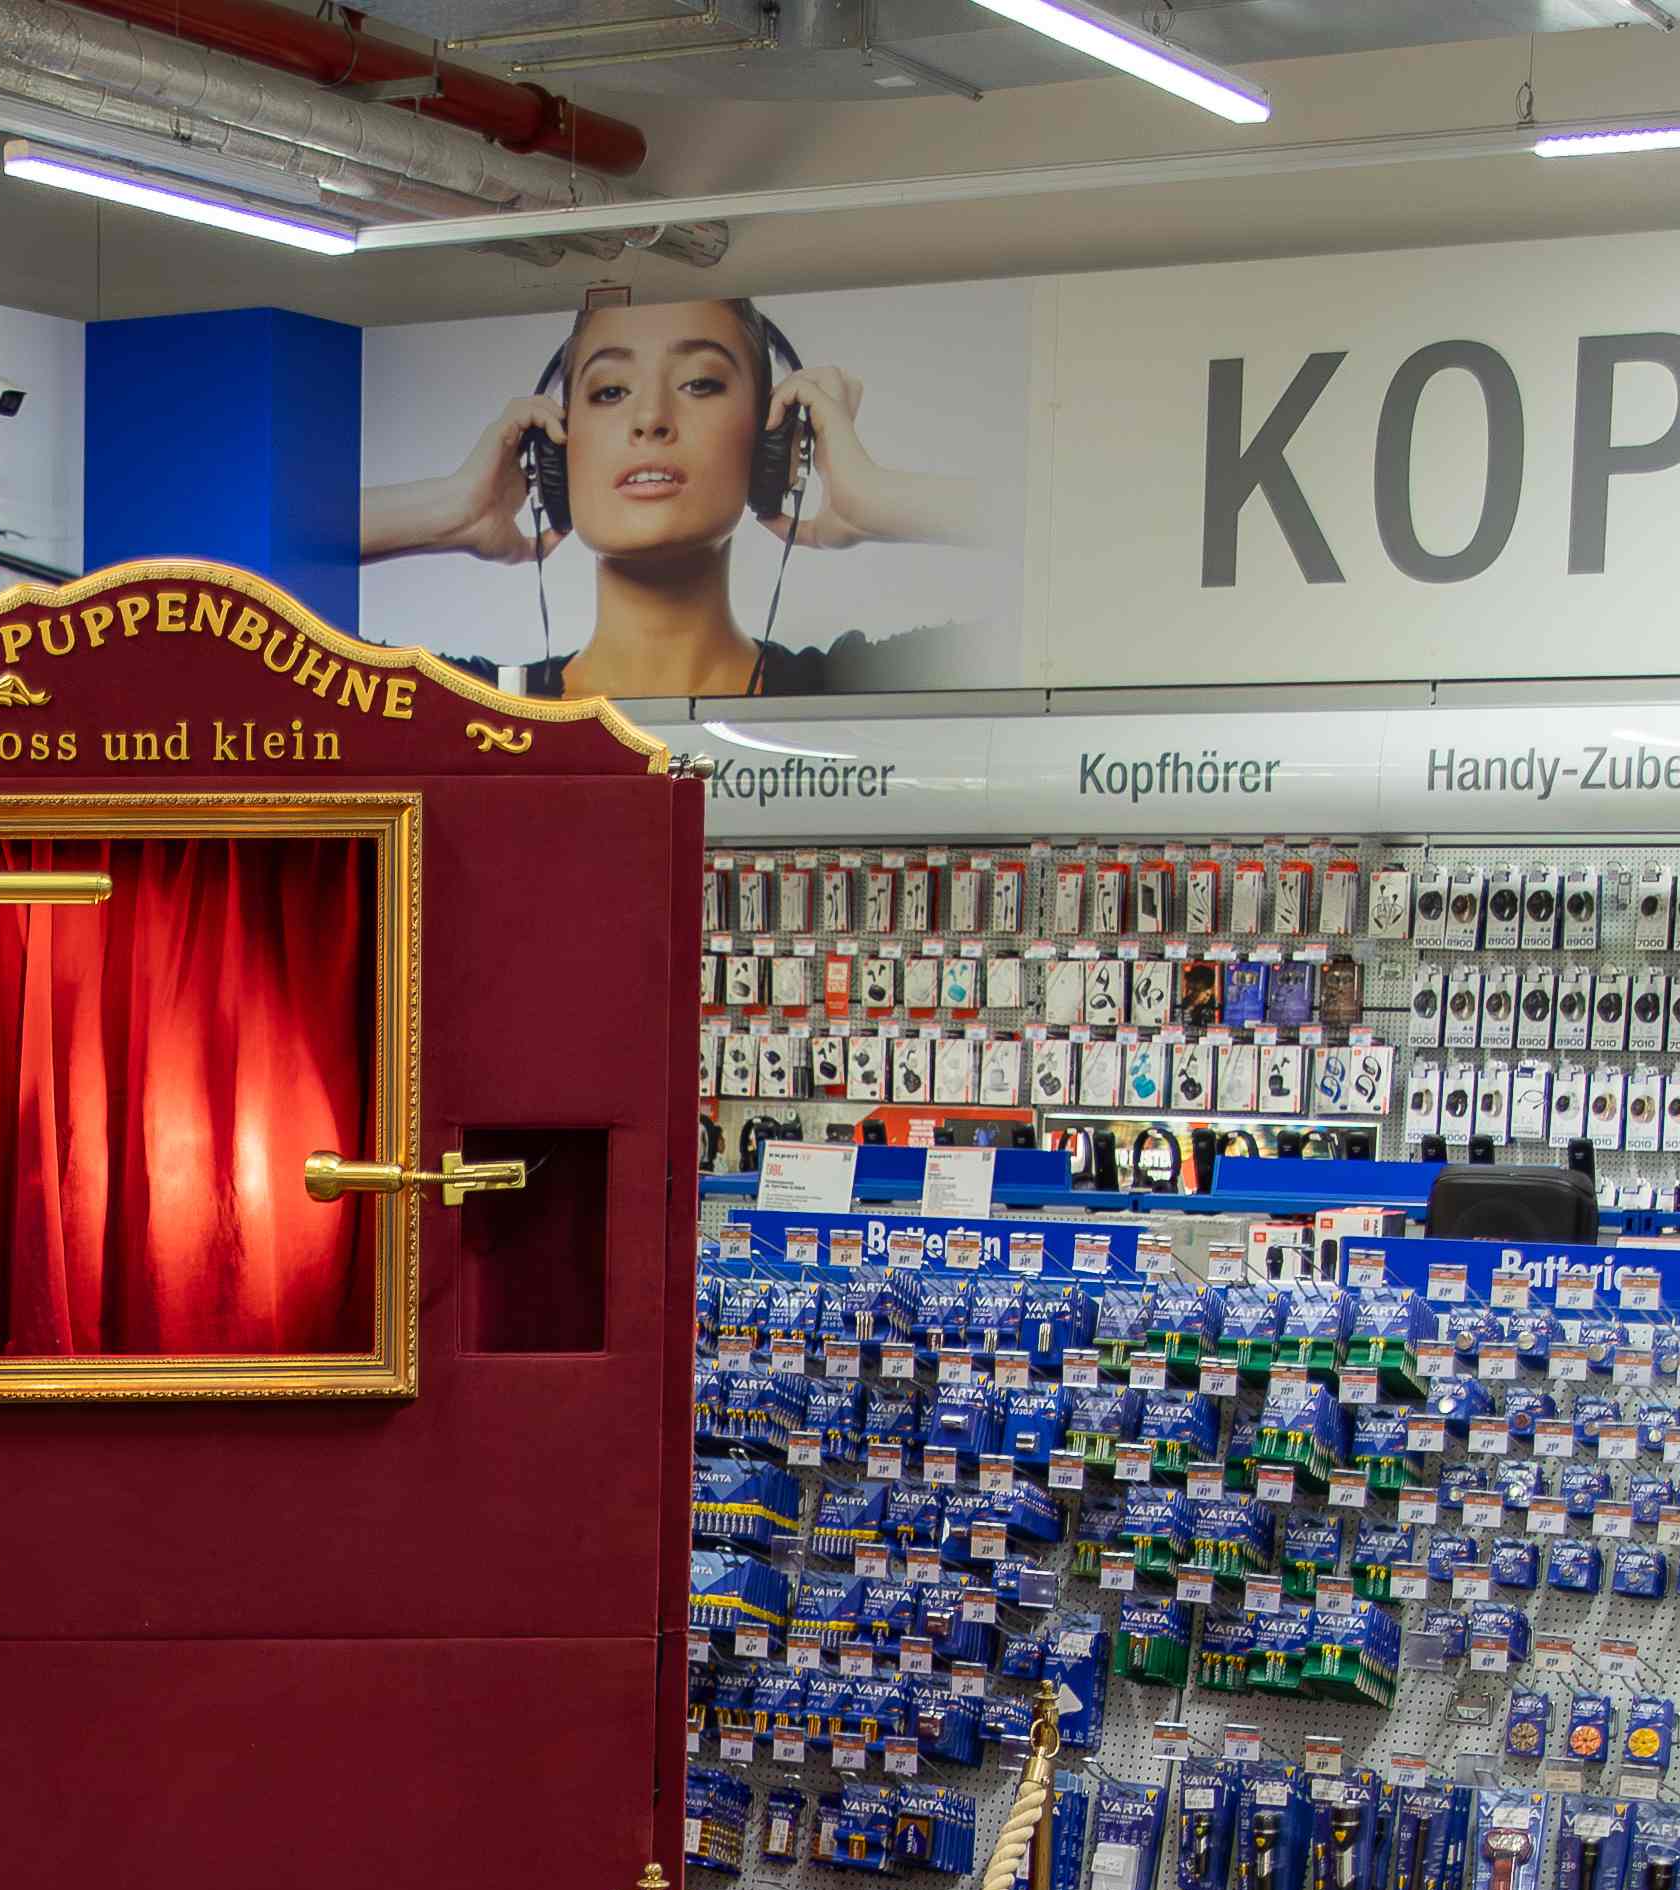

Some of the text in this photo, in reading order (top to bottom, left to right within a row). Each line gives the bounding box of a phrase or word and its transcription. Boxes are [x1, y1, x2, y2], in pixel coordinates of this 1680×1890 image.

[0, 590, 418, 721] PUPPENBÜHNE
[103, 720, 190, 763] und
[213, 718, 341, 763] klein
[709, 755, 896, 802] Kopfhörer
[1078, 749, 1281, 798] Kopfhörer
[848, 1281, 892, 1294] VARTA
[724, 1296, 767, 1309] VARTA
[772, 1296, 816, 1309] VARTA
[921, 1295, 965, 1308] VARTA
[975, 1297, 1020, 1309] VARTA
[1025, 1301, 1071, 1314] VARTA
[1155, 1299, 1203, 1312] VARTA
[1226, 1306, 1275, 1319] VARTA
[1288, 1306, 1337, 1318] VARTA
[1358, 1304, 1408, 1317] VARTA
[730, 1378, 774, 1391] VARTA
[939, 1385, 984, 1400] VARTA
[809, 1394, 853, 1408] VARTA
[1010, 1397, 1056, 1410] VARTA
[1269, 1399, 1316, 1411] VARTA
[1145, 1405, 1192, 1418] VARTA
[1356, 1422, 1406, 1433] VARTA
[834, 1495, 869, 1507] VARTA
[892, 1491, 937, 1505] VARTA
[945, 1495, 990, 1509] VARTA
[1126, 1504, 1173, 1518] VARTA
[1198, 1508, 1248, 1522] VARTA
[1287, 1529, 1336, 1543] VARTA
[1359, 1534, 1408, 1548] VARTA
[812, 1587, 846, 1598] VARTA
[867, 1588, 911, 1602] VARTA
[1122, 1610, 1169, 1623] VARTA
[1317, 1614, 1366, 1629] VARTA
[1259, 1619, 1308, 1634] VARTA
[757, 1677, 801, 1690] VARTA
[856, 1683, 901, 1699] VARTA
[842, 1801, 889, 1815] VARTA
[1102, 1800, 1154, 1817] VARTA
